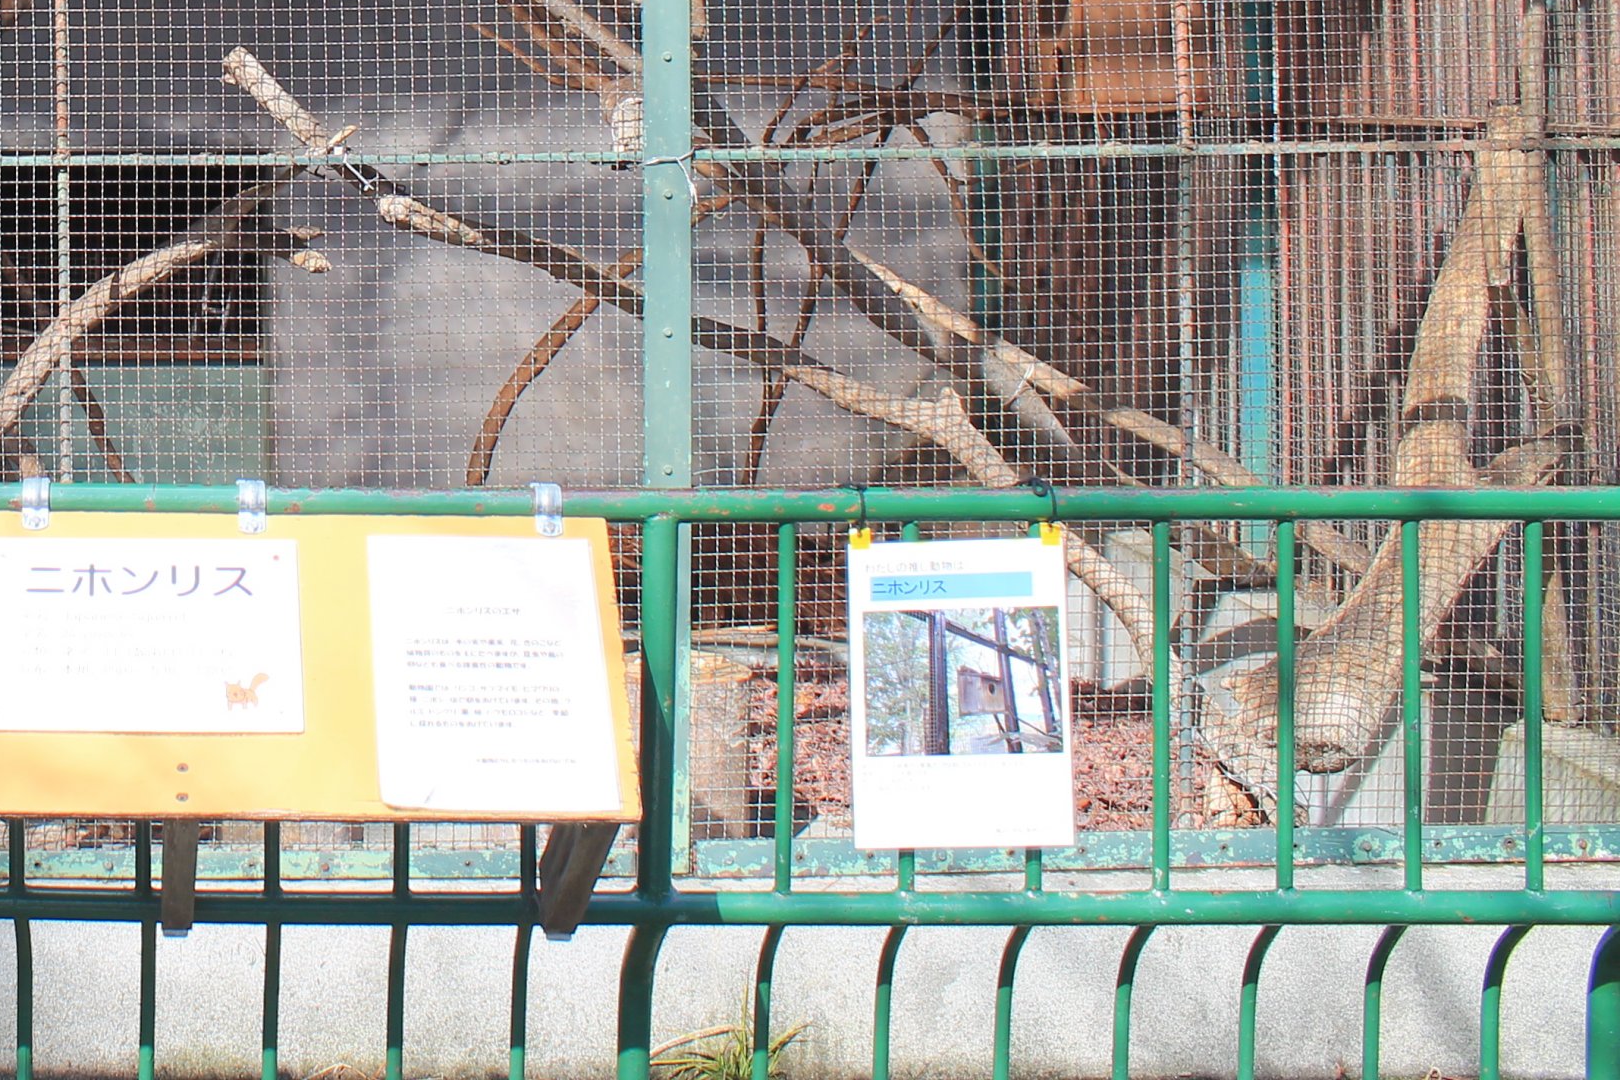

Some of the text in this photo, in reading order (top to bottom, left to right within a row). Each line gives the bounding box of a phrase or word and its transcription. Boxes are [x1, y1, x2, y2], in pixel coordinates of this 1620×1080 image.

[26, 563, 254, 597] ニホンリス
[871, 579, 948, 596] ニホンリス
